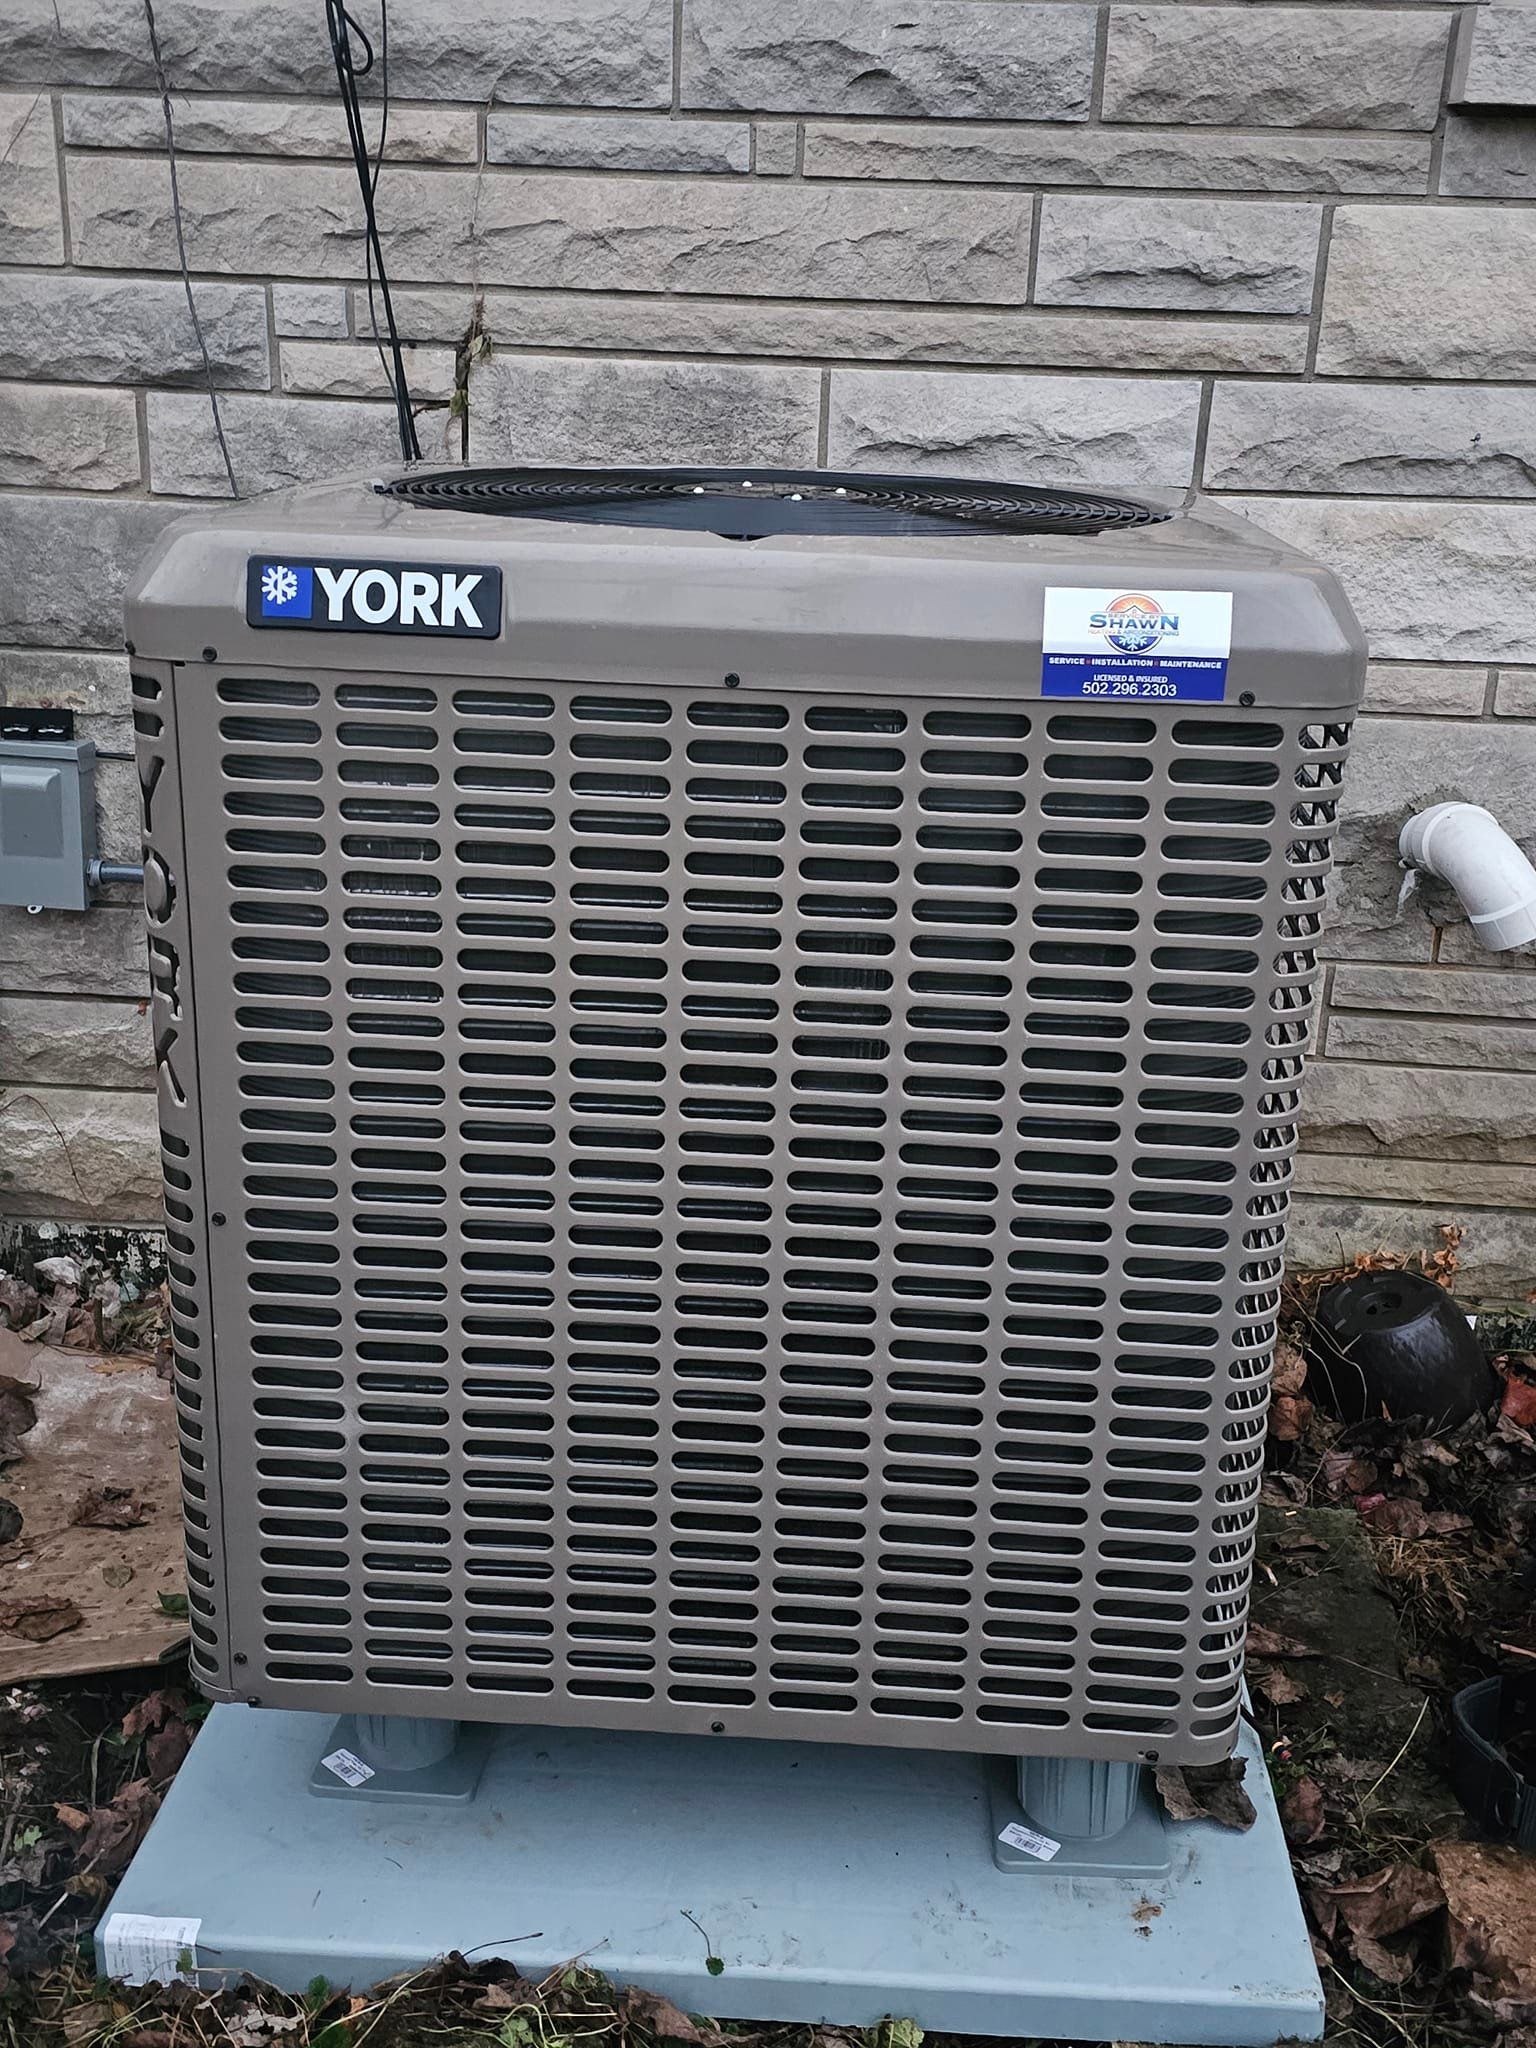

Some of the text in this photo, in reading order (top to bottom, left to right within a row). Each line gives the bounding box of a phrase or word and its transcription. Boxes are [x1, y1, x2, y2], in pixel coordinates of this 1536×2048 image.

[314, 566, 484, 629] YORK
[1089, 613, 1180, 631] SHAWN
[1108, 612, 1148, 620] SERVICE
[1049, 657, 1222, 669] SERVICE INSTALLATION MAINTENANCE
[1093, 674, 1169, 684] LICENSED & INSURED
[1082, 681, 1177, 697] 502.296.2303
